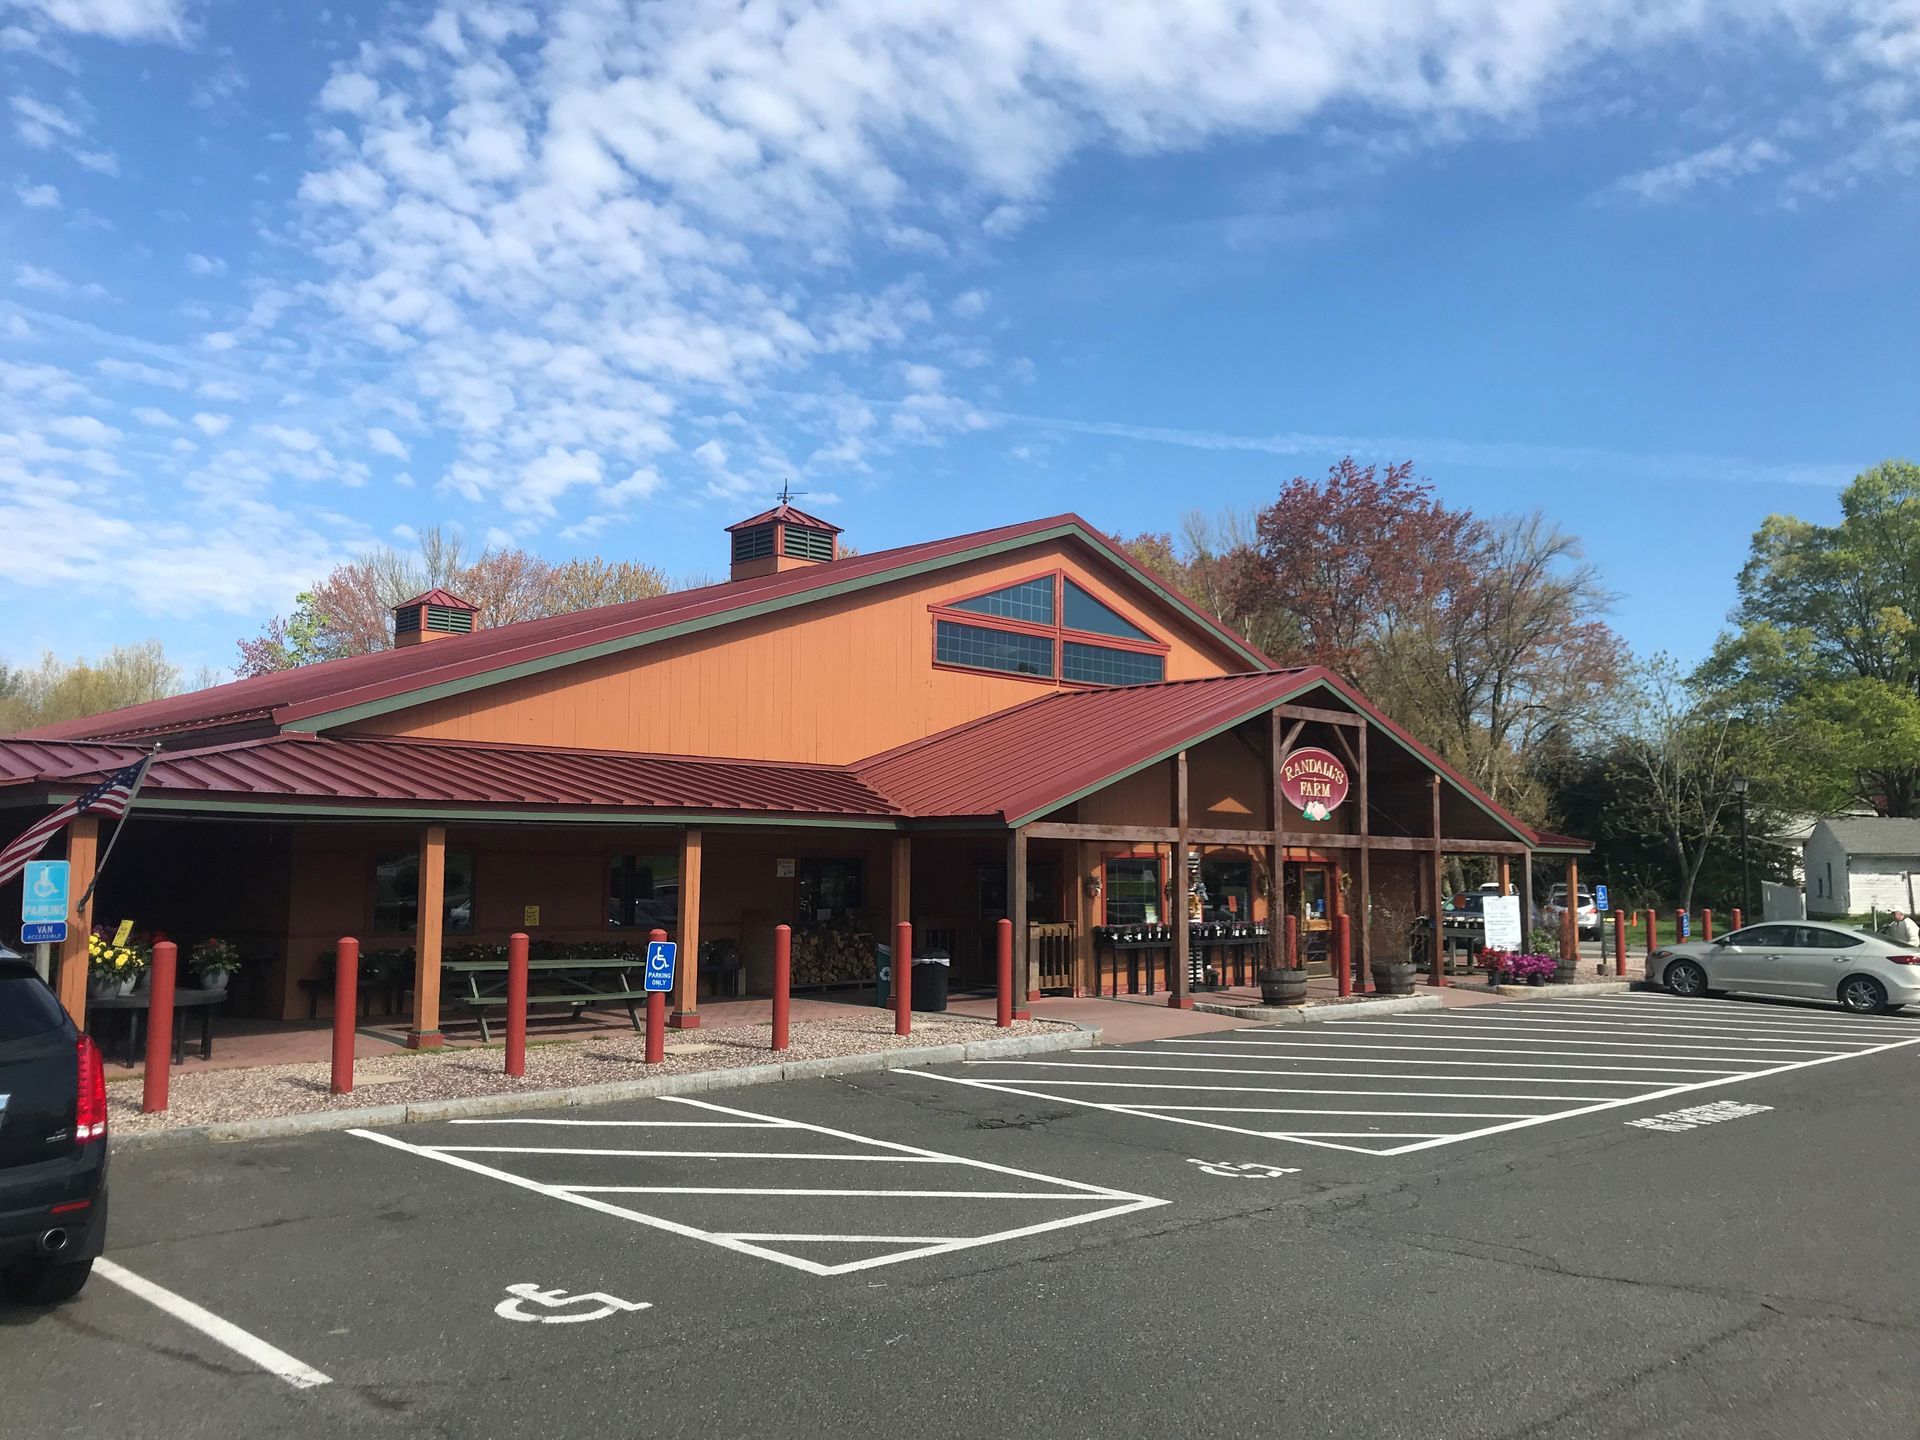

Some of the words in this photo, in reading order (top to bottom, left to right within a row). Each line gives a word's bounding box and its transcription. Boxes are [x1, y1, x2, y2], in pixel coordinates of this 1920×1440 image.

[1285, 758, 1345, 785] RANDALL'S
[1300, 781, 1331, 798] FARM
[37, 925, 53, 934] VAN
[648, 971, 671, 979] PARKING
